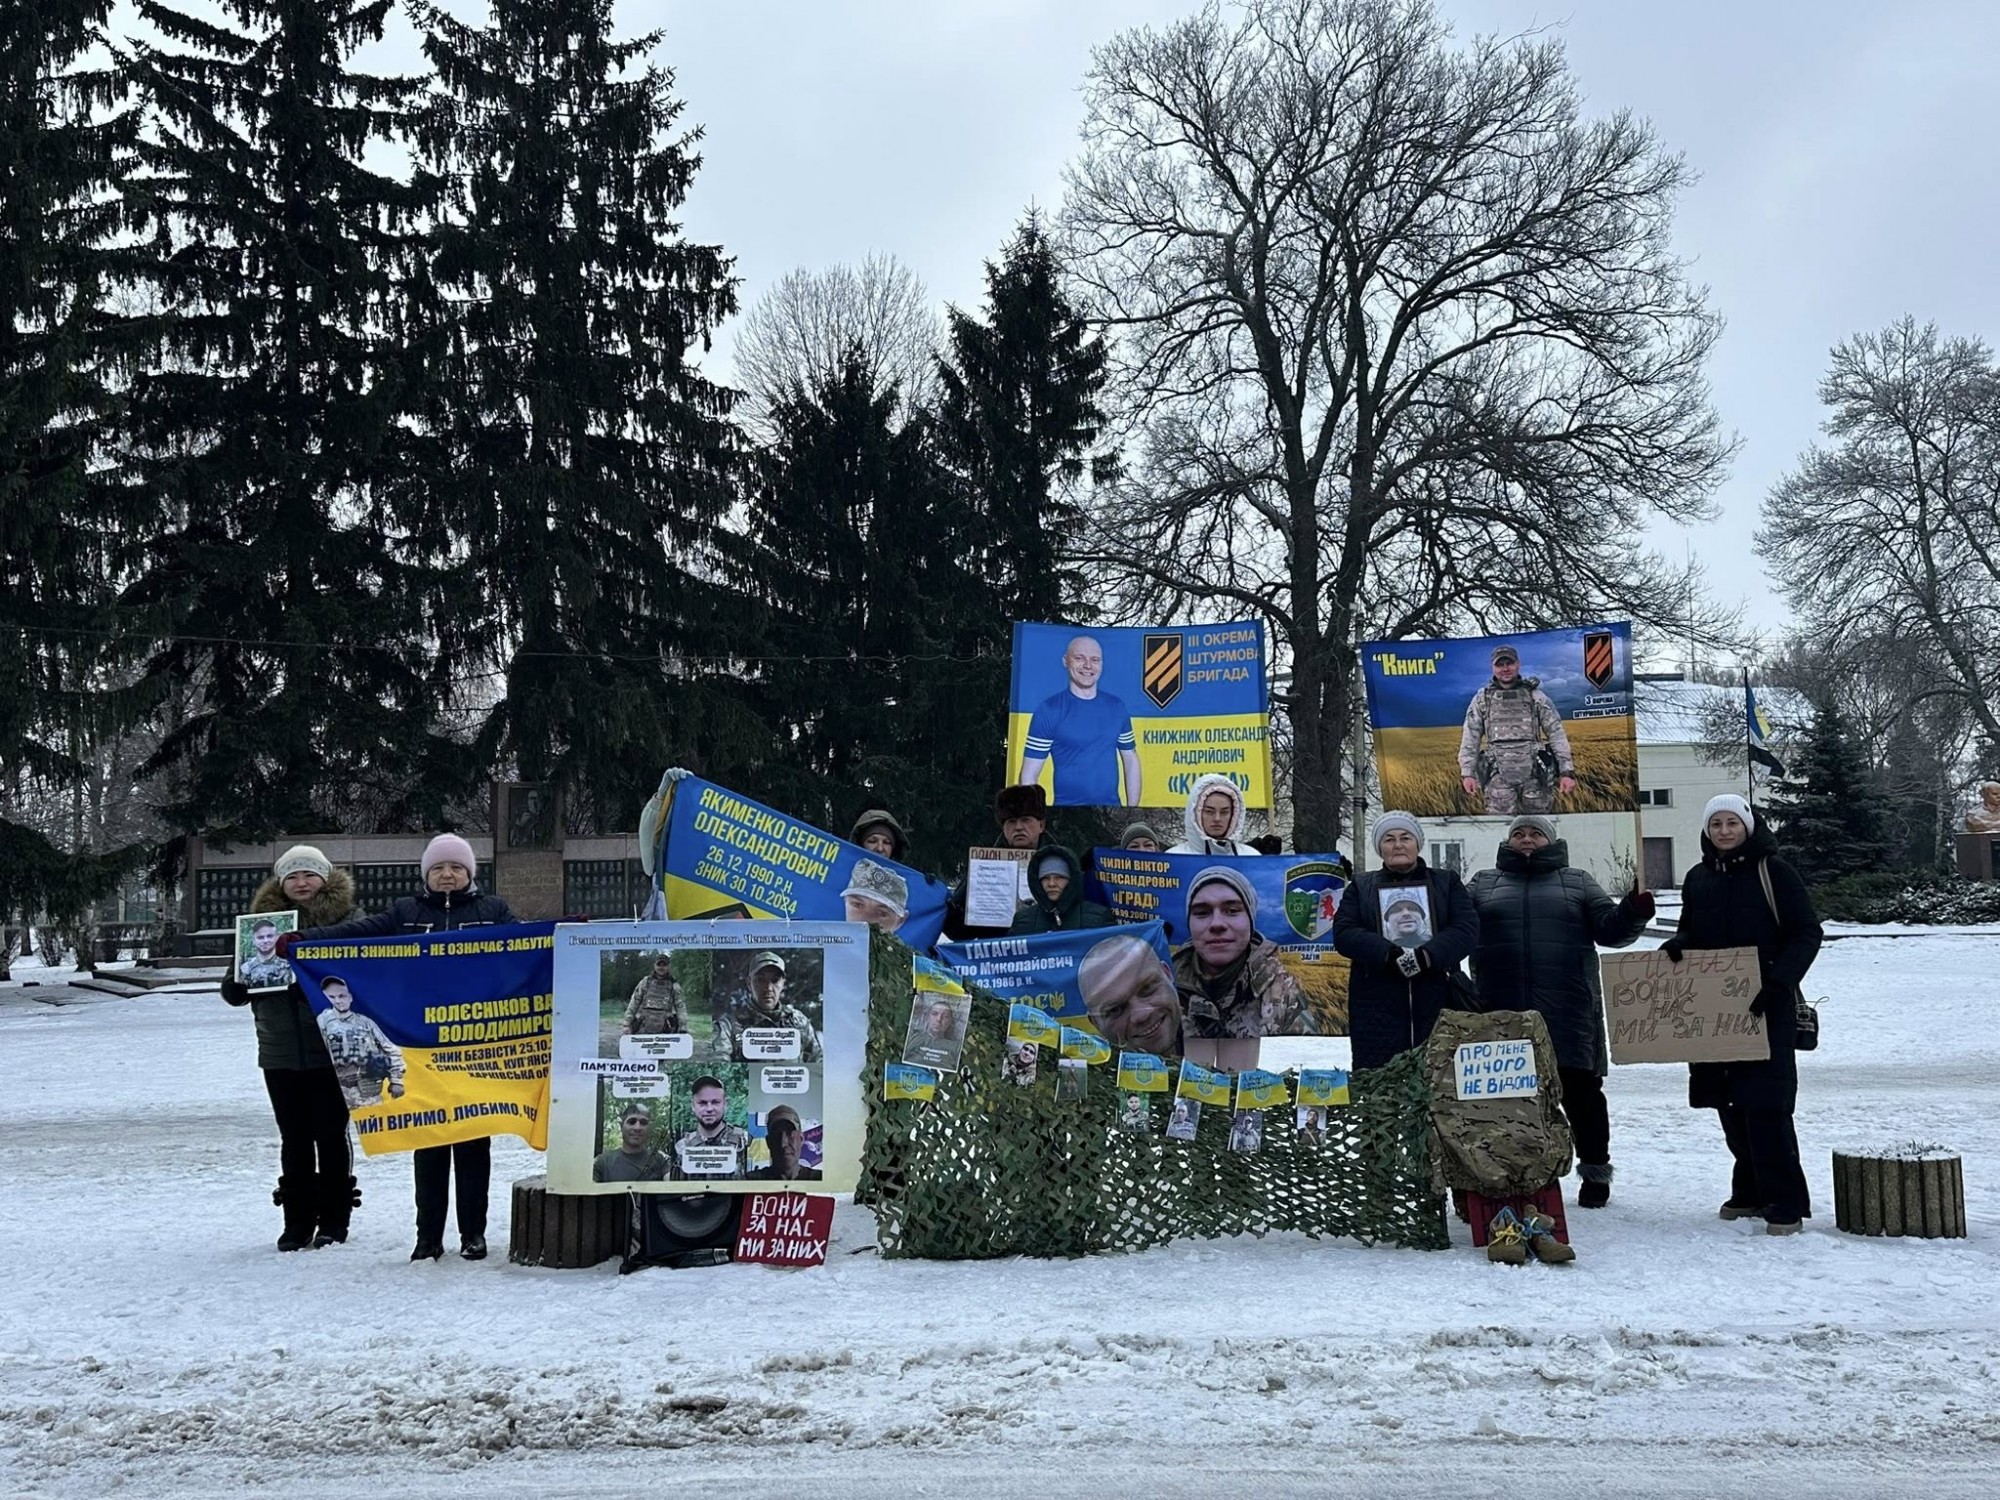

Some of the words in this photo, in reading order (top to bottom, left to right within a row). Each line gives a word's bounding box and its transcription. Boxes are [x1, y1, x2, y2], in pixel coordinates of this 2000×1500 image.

[1203, 629, 1257, 646] ОКРЕМА
[1188, 667, 1249, 683] БРИГАДА
[1143, 730, 1202, 744] КНИЖНИК
[1172, 747, 1245, 765] АНДРІЙОВИЧ
[699, 787, 786, 839] ЯКИМЕНКО
[786, 826, 840, 864] СЕРГІЙ
[694, 811, 829, 884] ОЛЕКСАНДРОВИЧ
[695, 861, 730, 885] ЗНИК
[1100, 857, 1131, 870] ЧИЛІЙ
[1134, 860, 1170, 873] ВІКТОР
[296, 946, 358, 960] БЕЗВІСТИ
[360, 942, 420, 958] ЗНИКЛИЙ
[430, 943, 445, 956] НЕ
[447, 940, 504, 955] ОЗНАЧАЄ
[965, 939, 1028, 960] ГАГАРІН
[980, 956, 1073, 975] Миколайович
[1613, 977, 1698, 1007] ВОНИ
[1721, 976, 1749, 997] ЗА
[425, 997, 530, 1024] КОЛЄСНІКОВ
[1648, 996, 1695, 1020] НАС
[438, 1014, 553, 1043] ВОЛОДИМИРО
[1612, 1019, 1660, 1044] МИ
[1672, 1016, 1704, 1038] ЗА
[1712, 1012, 1763, 1037] НИХ
[431, 1050, 461, 1063] ЗНИК
[465, 1044, 517, 1061] БЕЗВІСТИ
[519, 1039, 551, 1055] 25.10.
[1460, 1044, 1491, 1063] ПРО
[1496, 1043, 1527, 1056] МЕНЕ
[581, 1062, 656, 1072] ПАМ'ЯТАЄМО
[1464, 1056, 1526, 1076] НІЧОГО
[1464, 1079, 1482, 1094] НЕ
[355, 1114, 384, 1135] ИЙ!
[387, 1109, 450, 1131] ВІРИМО,
[453, 1102, 523, 1122] ЛЮБИМО,
[752, 1194, 808, 1217] ВОНИ
[746, 1215, 766, 1234] ЗА
[775, 1217, 815, 1237] НАС
[738, 1237, 765, 1257] МИ
[767, 1238, 785, 1258] ЗА
[786, 1239, 826, 1260] НИХ
